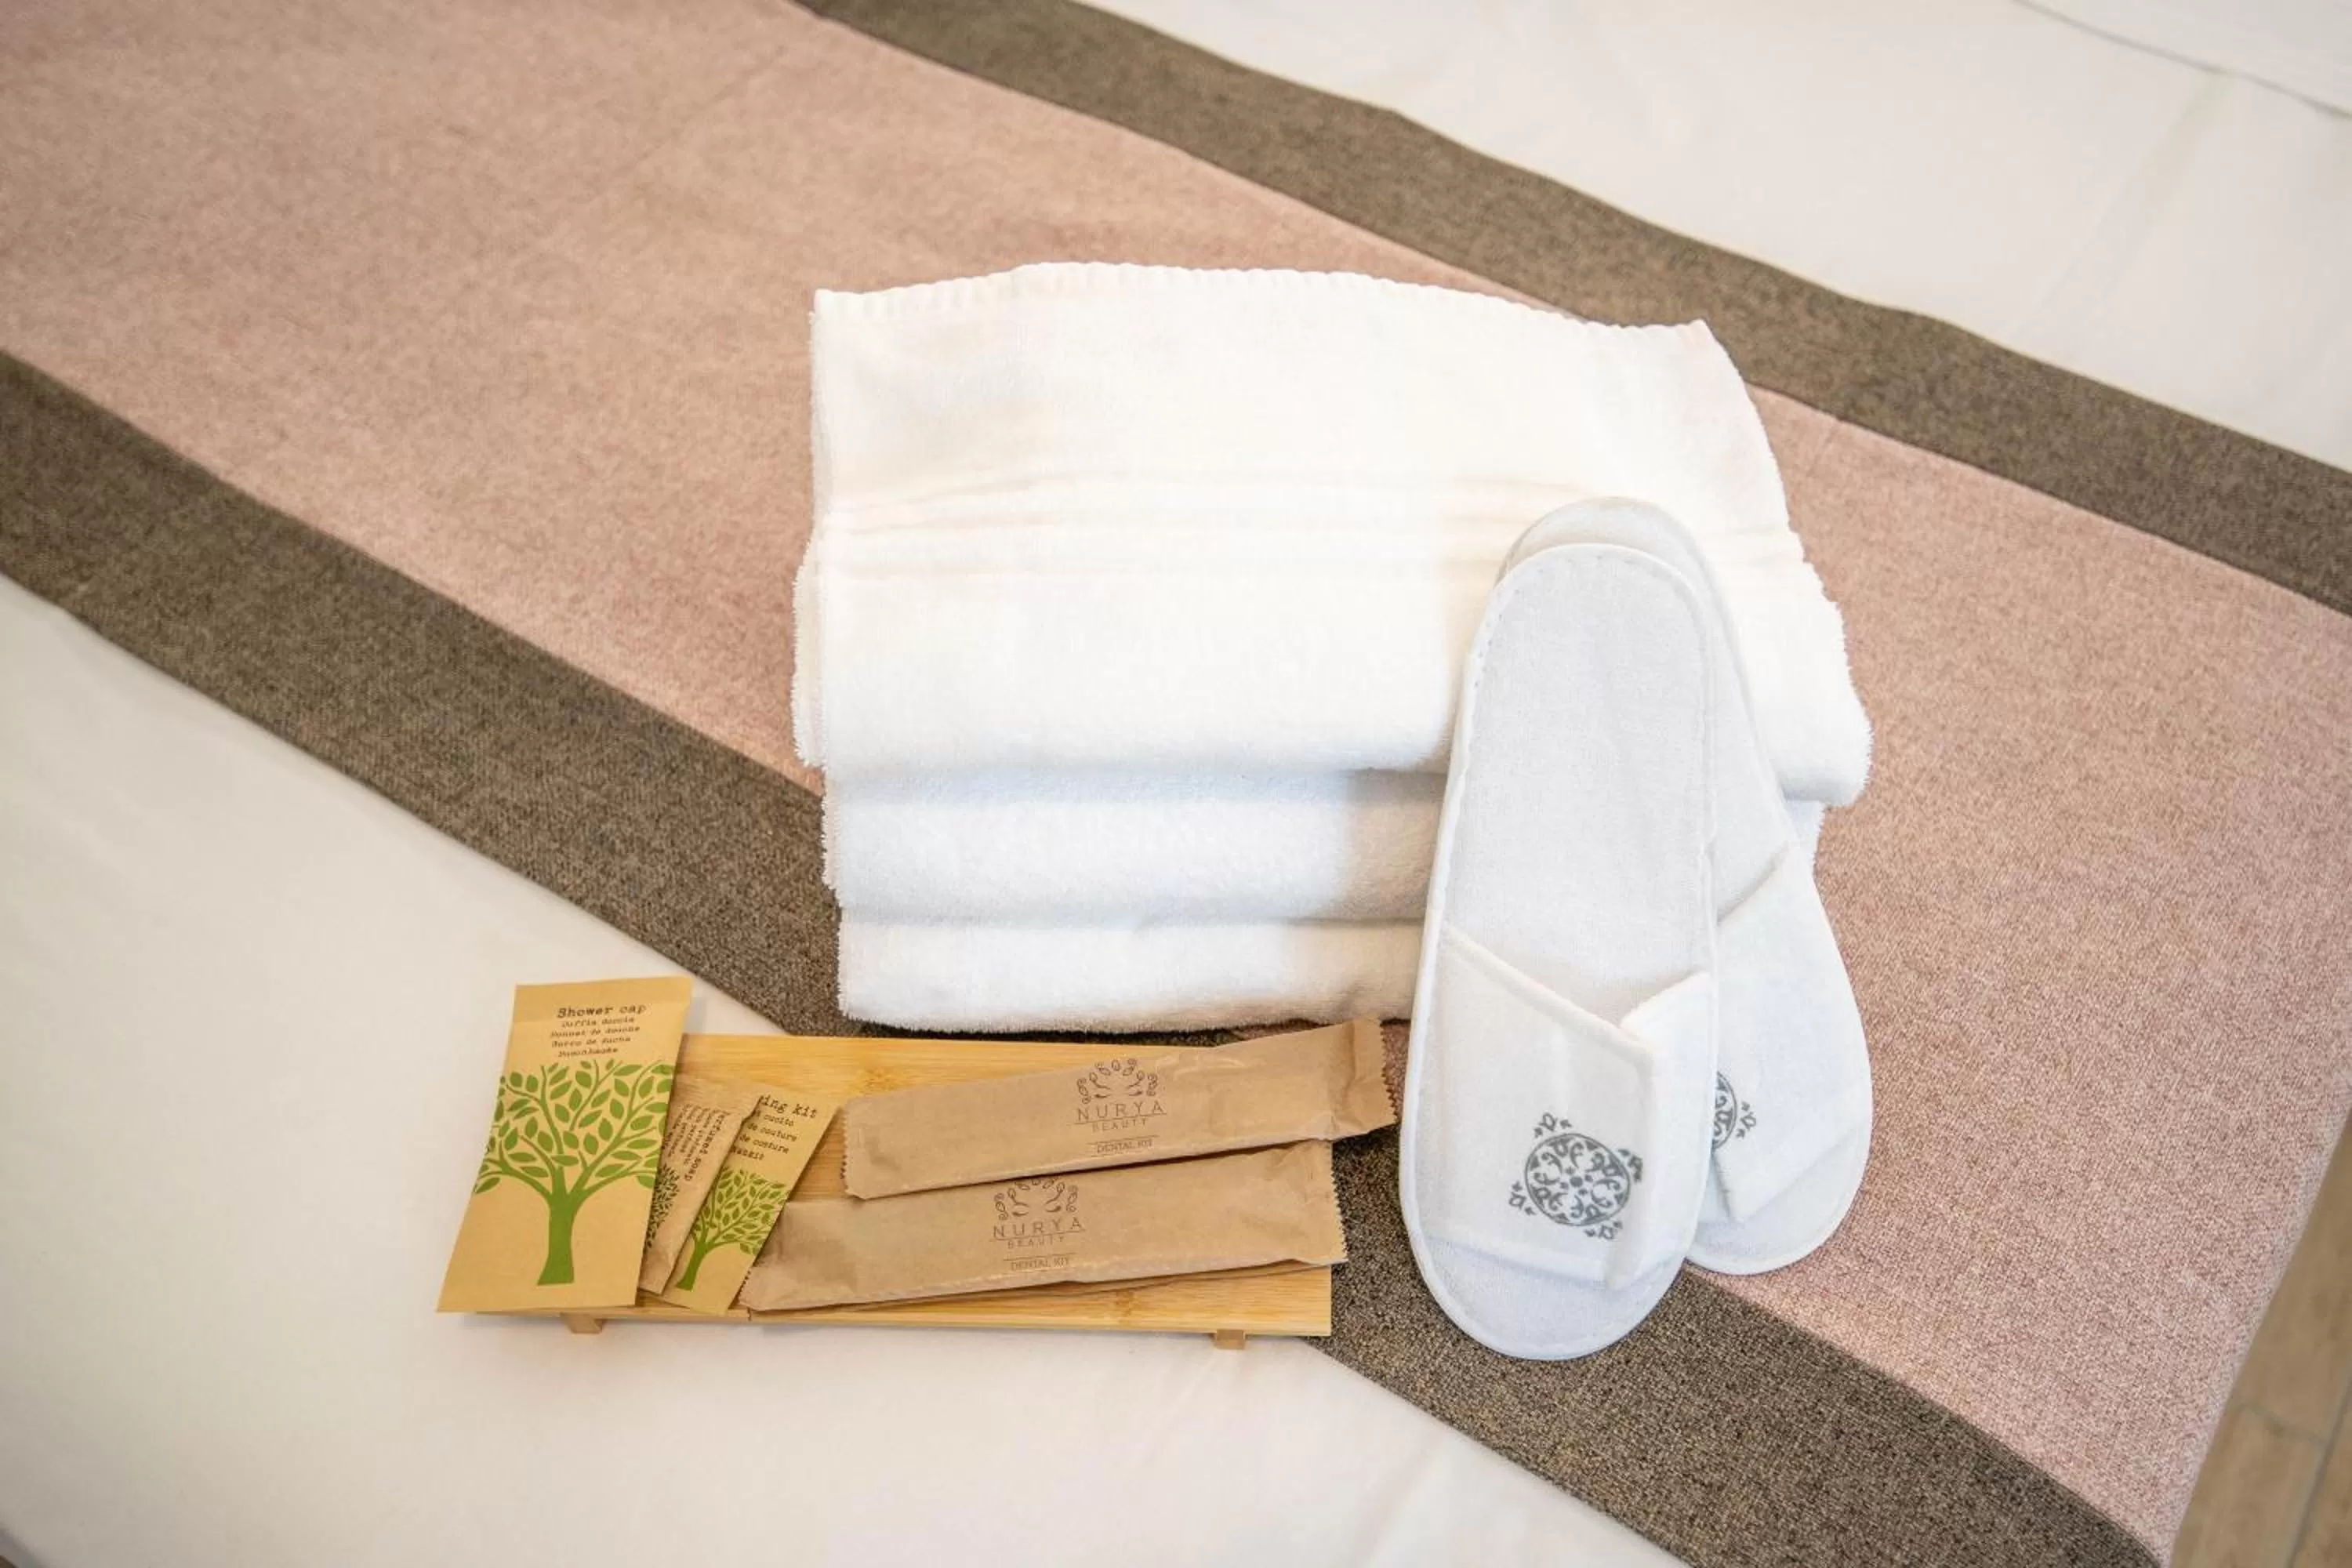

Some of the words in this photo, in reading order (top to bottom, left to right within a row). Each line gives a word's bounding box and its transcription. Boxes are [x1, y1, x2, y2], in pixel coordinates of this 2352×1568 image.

[557, 1006, 613, 1018] Shower
[619, 1004, 646, 1014] cap
[760, 1095, 789, 1113] ing
[792, 1103, 817, 1119] kit
[1076, 1100, 1164, 1121] NURYA
[1092, 1118, 1148, 1132] BEAUTY
[1097, 1142, 1134, 1153] DENTAL
[993, 1217, 1083, 1239] NURYA
[1007, 1236, 1064, 1250] BEAUTY
[1011, 1260, 1051, 1271] DENTAL
[1054, 1258, 1069, 1266] KIT
